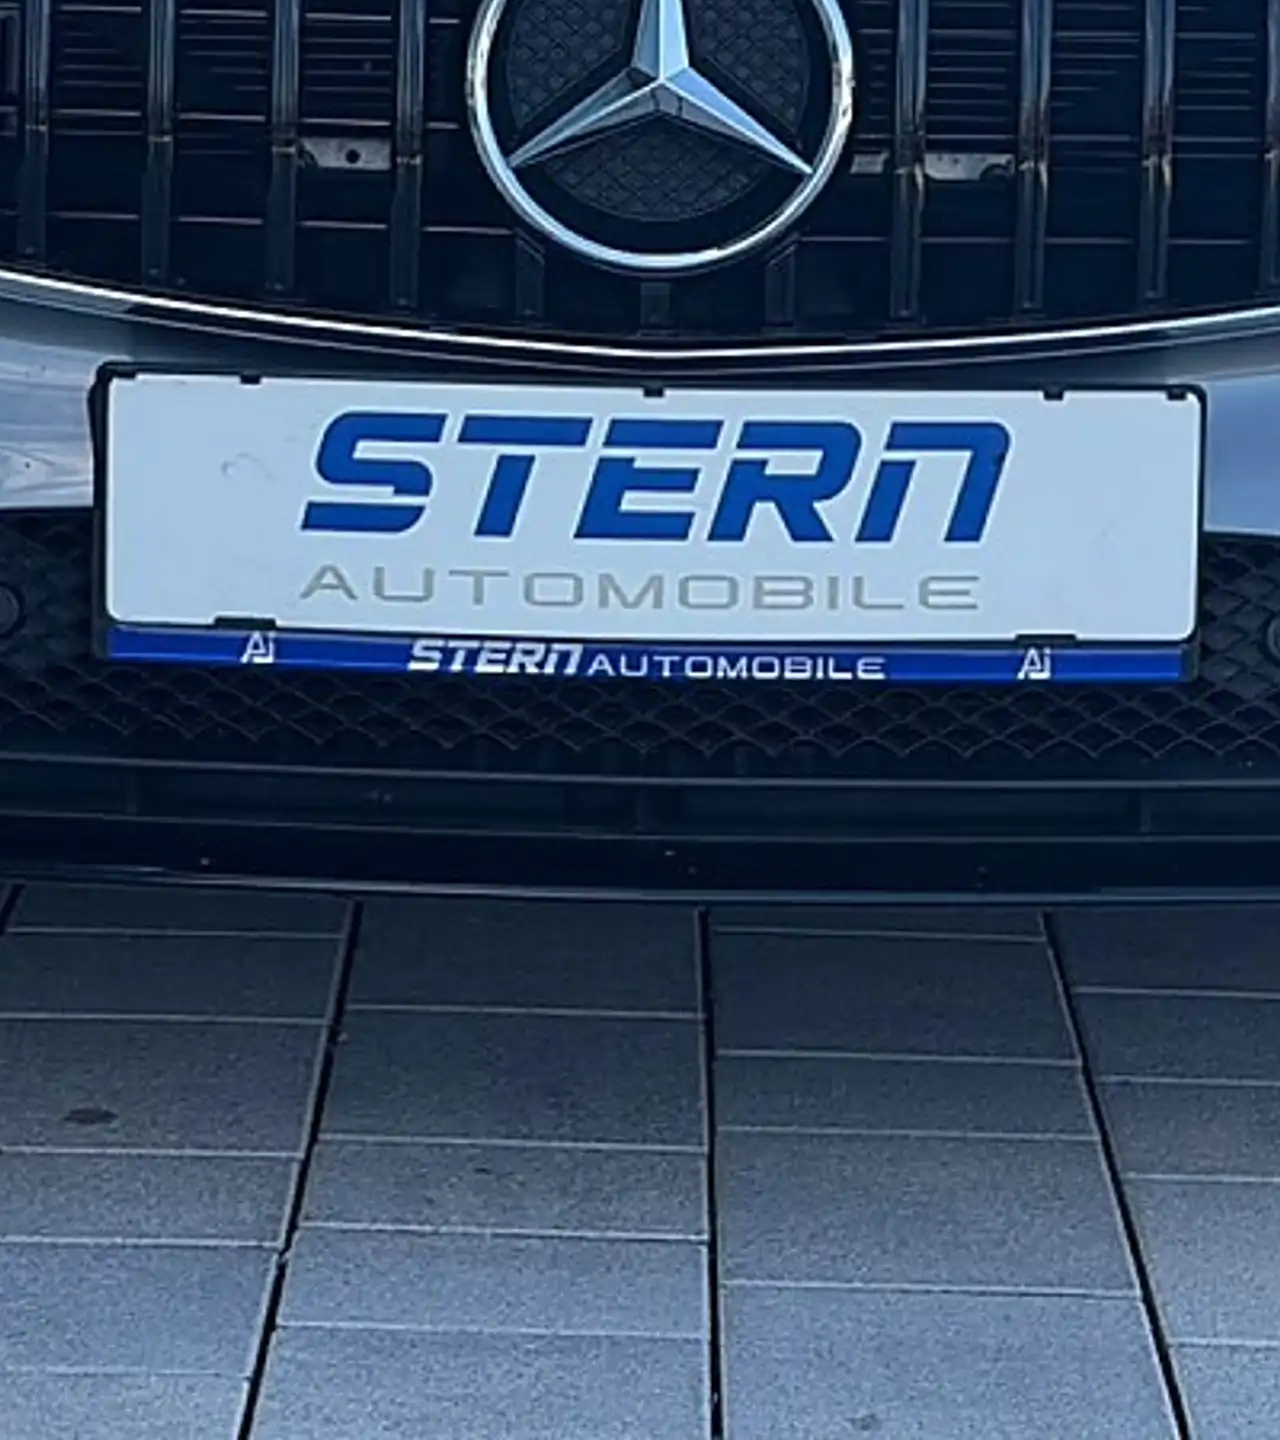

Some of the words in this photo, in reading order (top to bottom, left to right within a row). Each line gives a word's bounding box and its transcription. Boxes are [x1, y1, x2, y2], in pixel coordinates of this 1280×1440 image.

[300, 411, 1011, 543] STERN
[299, 563, 980, 610] AUTOMOBILE
[407, 638, 583, 675] STERN
[586, 654, 886, 680] AUTOMOBILE
